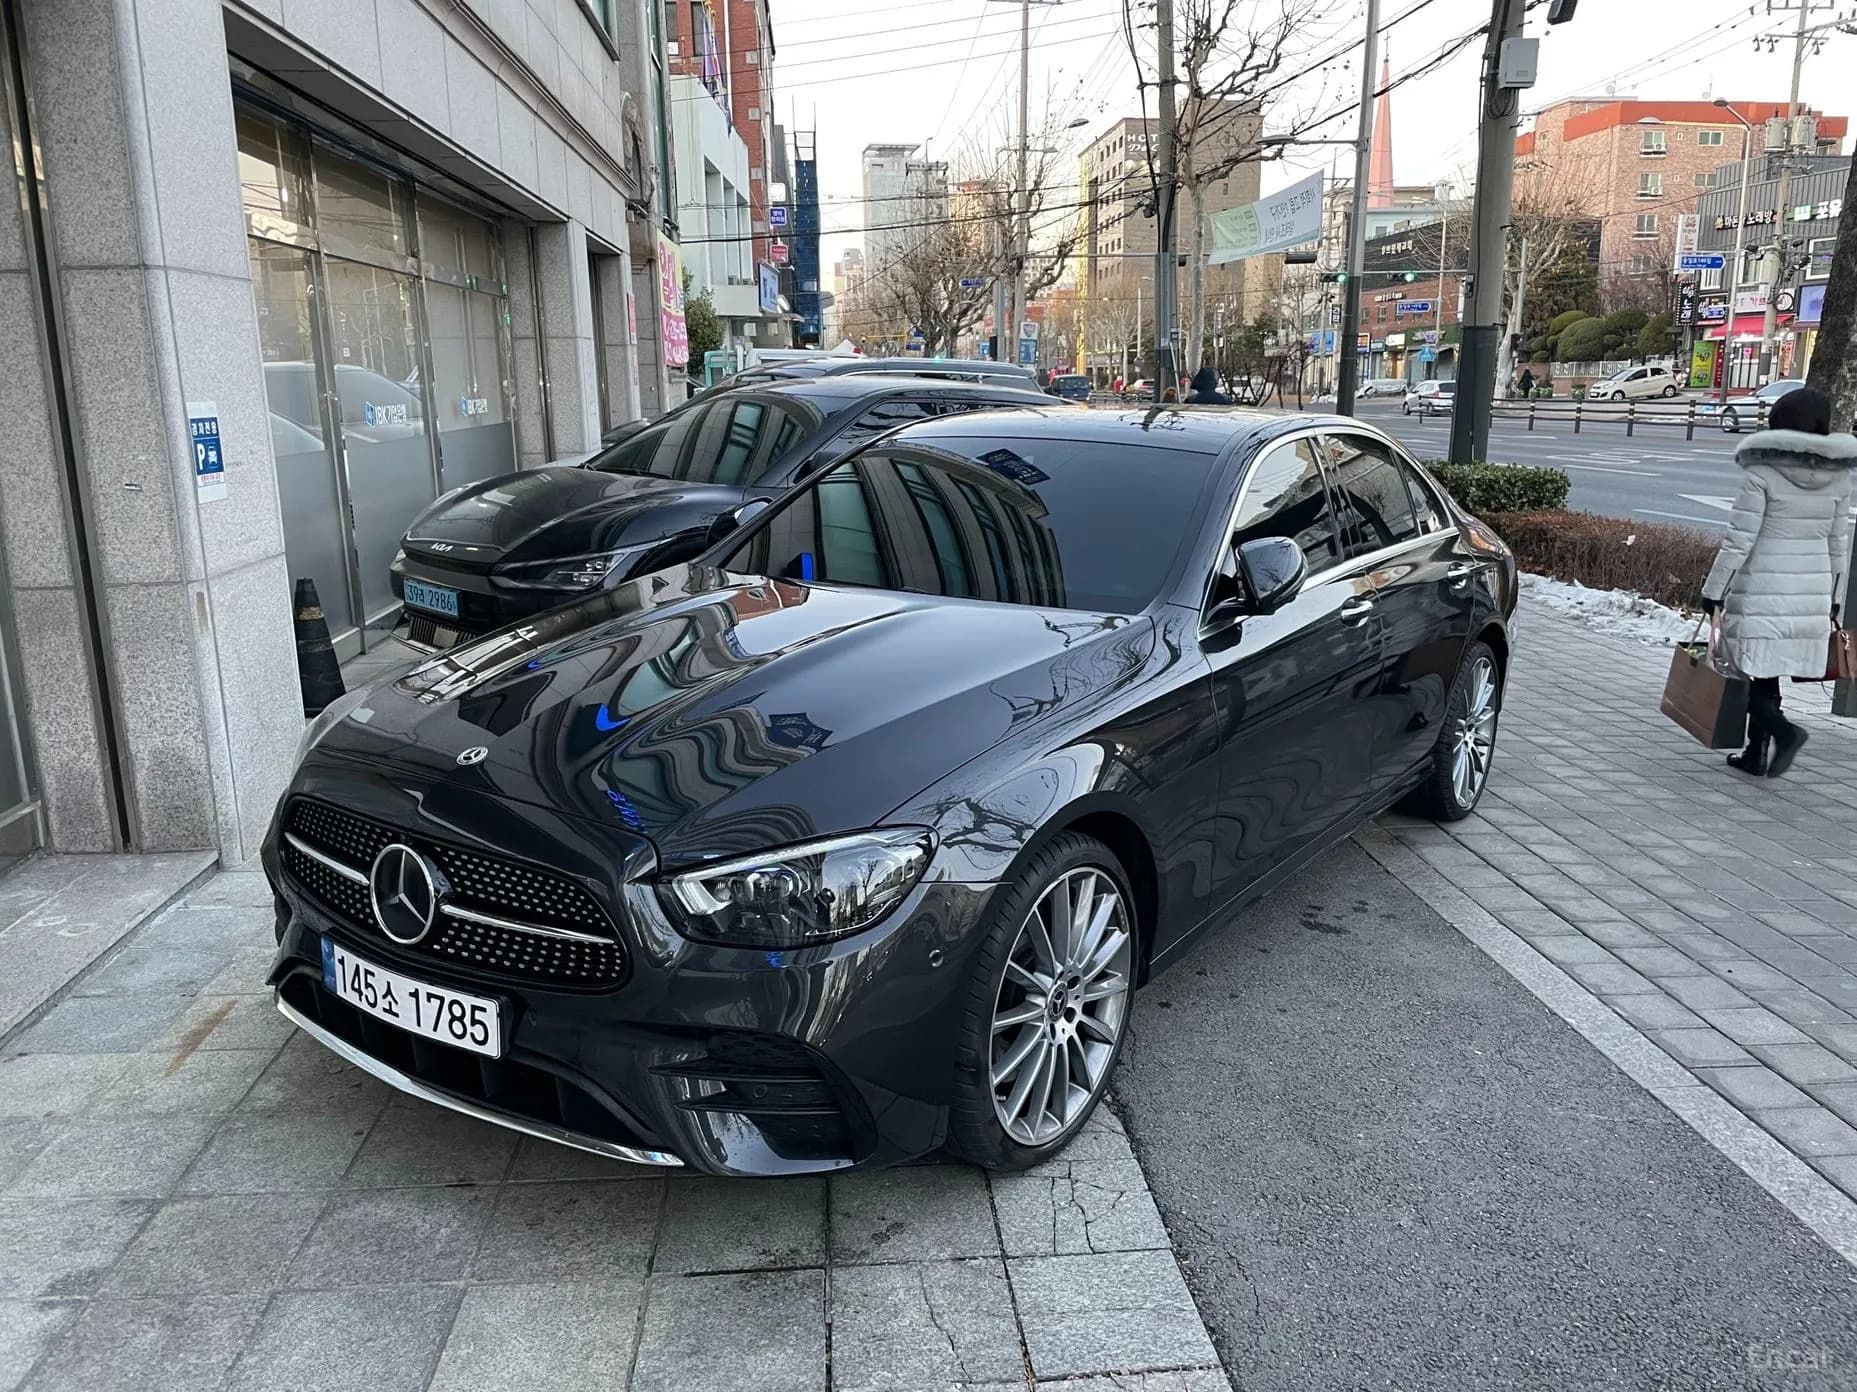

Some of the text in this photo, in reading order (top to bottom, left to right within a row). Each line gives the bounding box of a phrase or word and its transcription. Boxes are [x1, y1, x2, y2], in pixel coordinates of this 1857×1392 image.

[428, 590, 453, 611] 2986
[337, 955, 489, 1046] 145소 1785
